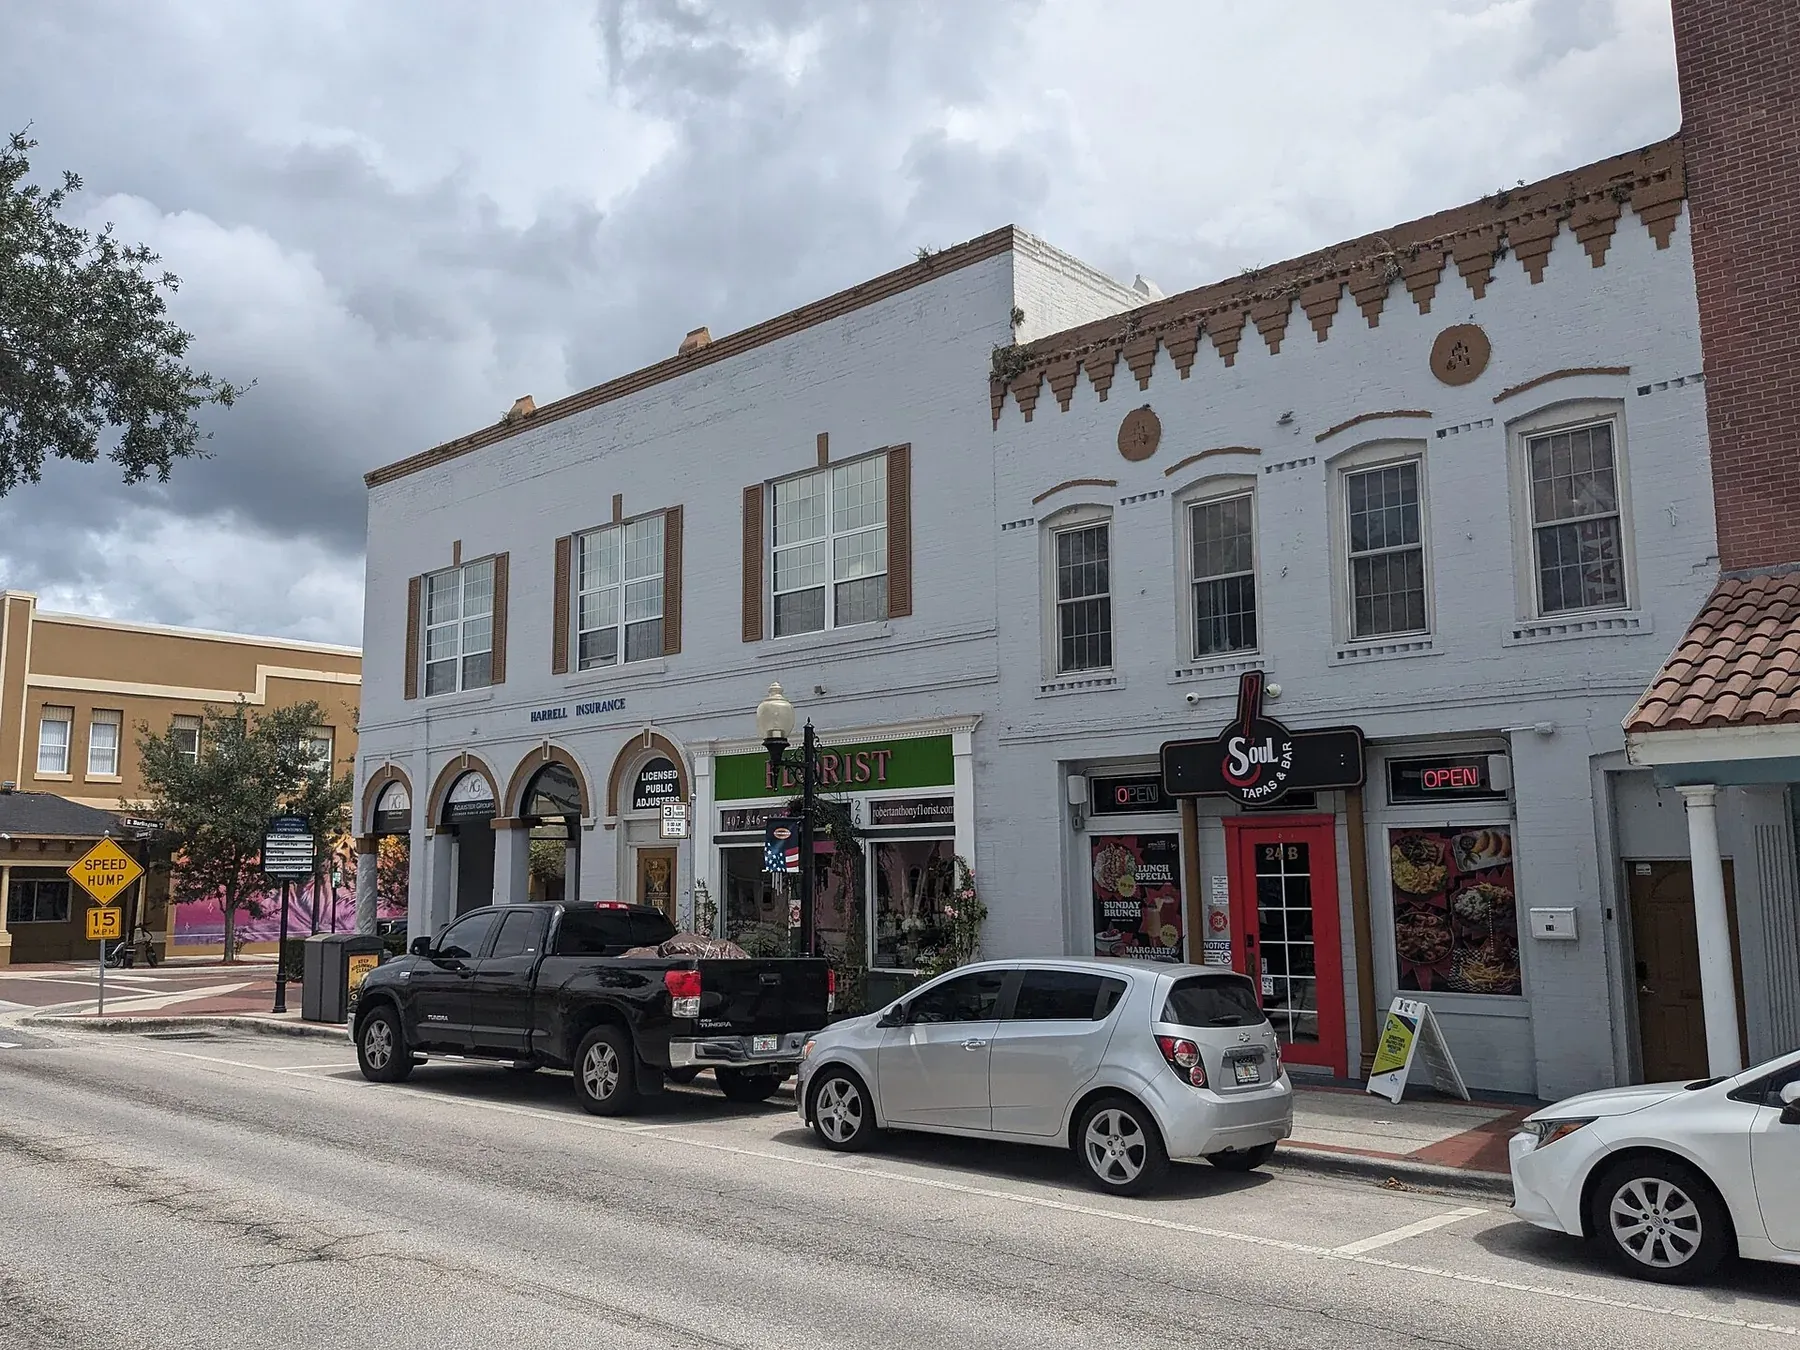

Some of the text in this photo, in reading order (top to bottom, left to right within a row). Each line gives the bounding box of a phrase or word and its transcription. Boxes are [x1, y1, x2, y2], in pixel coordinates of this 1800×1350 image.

[531, 698, 626, 722] HARRELL INSURANCE
[641, 770, 678, 781] LICENSED
[1241, 741, 1293, 799] TAPAS & BAR
[1424, 768, 1477, 788] OPEN
[645, 783, 673, 794] PUBLIC
[1117, 786, 1156, 803] OPEN
[665, 807, 672, 816] 3
[1265, 846, 1299, 861] 24 B
[84, 859, 127, 870] SPEED
[1138, 864, 1169, 873] LUNCH
[87, 874, 125, 886] HUMP
[1135, 873, 1174, 881] SPECIAL
[1103, 901, 1141, 909] SUNDAY
[1104, 909, 1142, 917] BRUNCH
[92, 911, 116, 927] 15
[1126, 946, 1176, 955] MARGARITA
[1203, 942, 1230, 950] NOTICE
